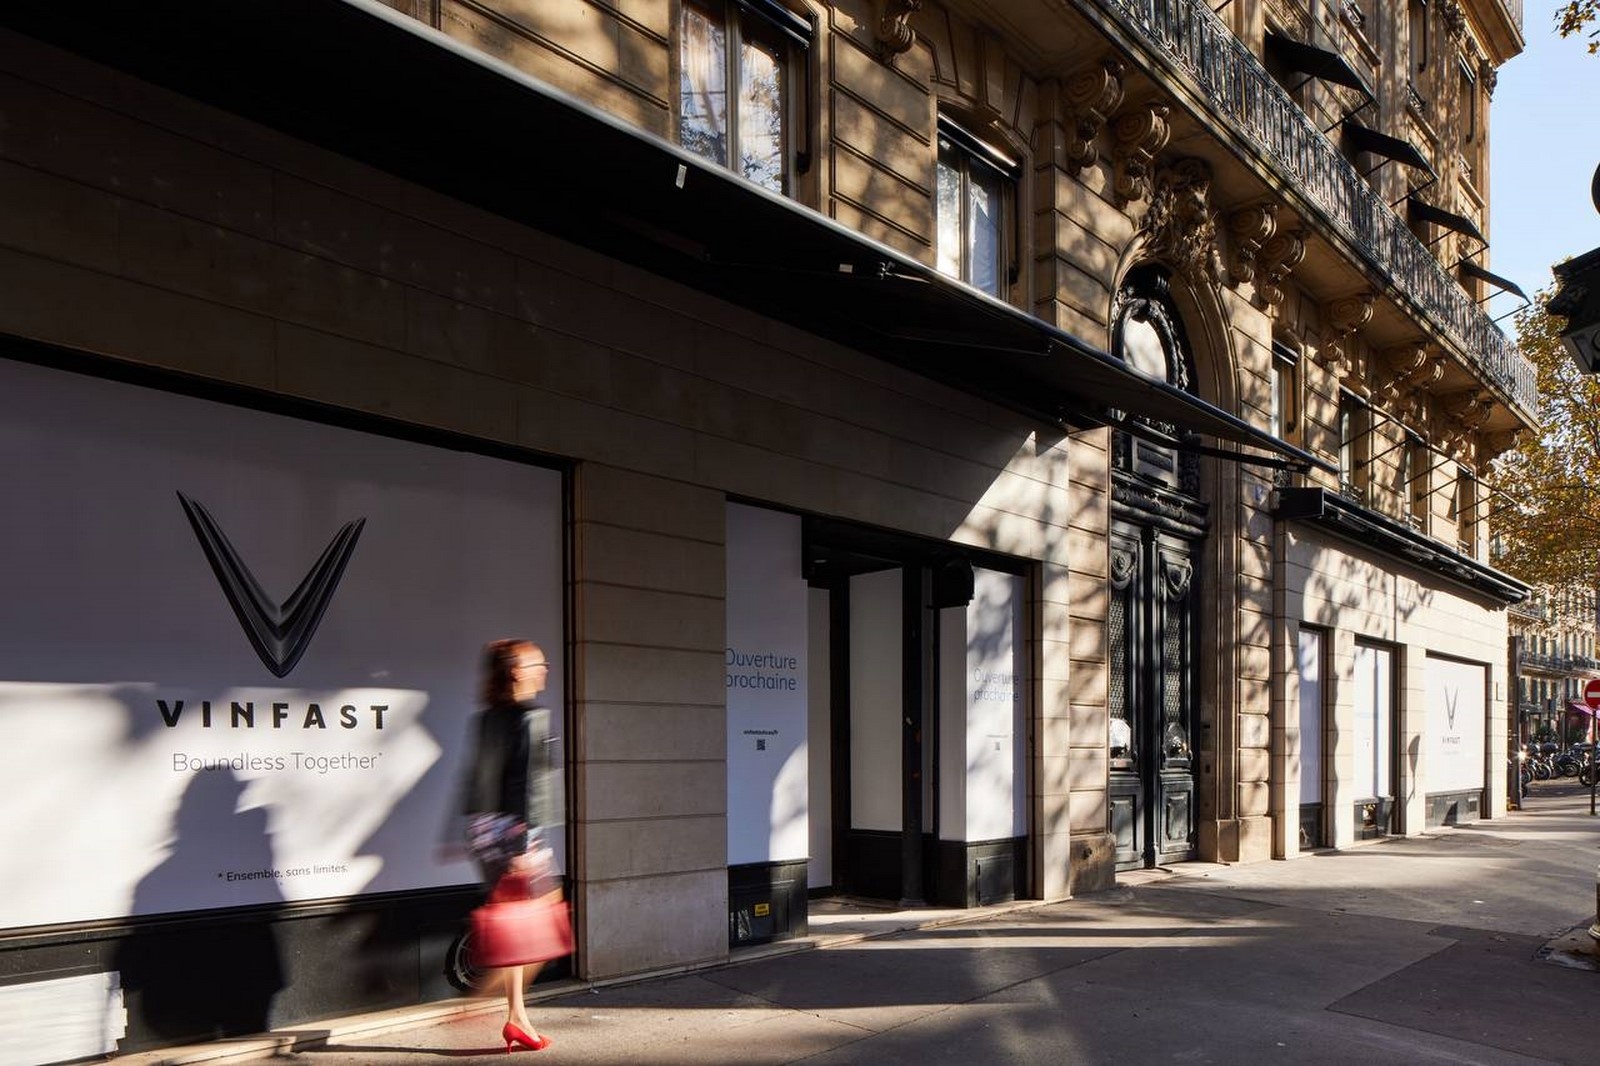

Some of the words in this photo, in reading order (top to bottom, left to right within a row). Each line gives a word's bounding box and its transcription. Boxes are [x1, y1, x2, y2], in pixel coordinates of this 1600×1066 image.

[725, 647, 796, 669] Ouverture
[157, 699, 389, 729] VINFAST
[172, 752, 286, 772] Boundless
[285, 867, 311, 878] sans
